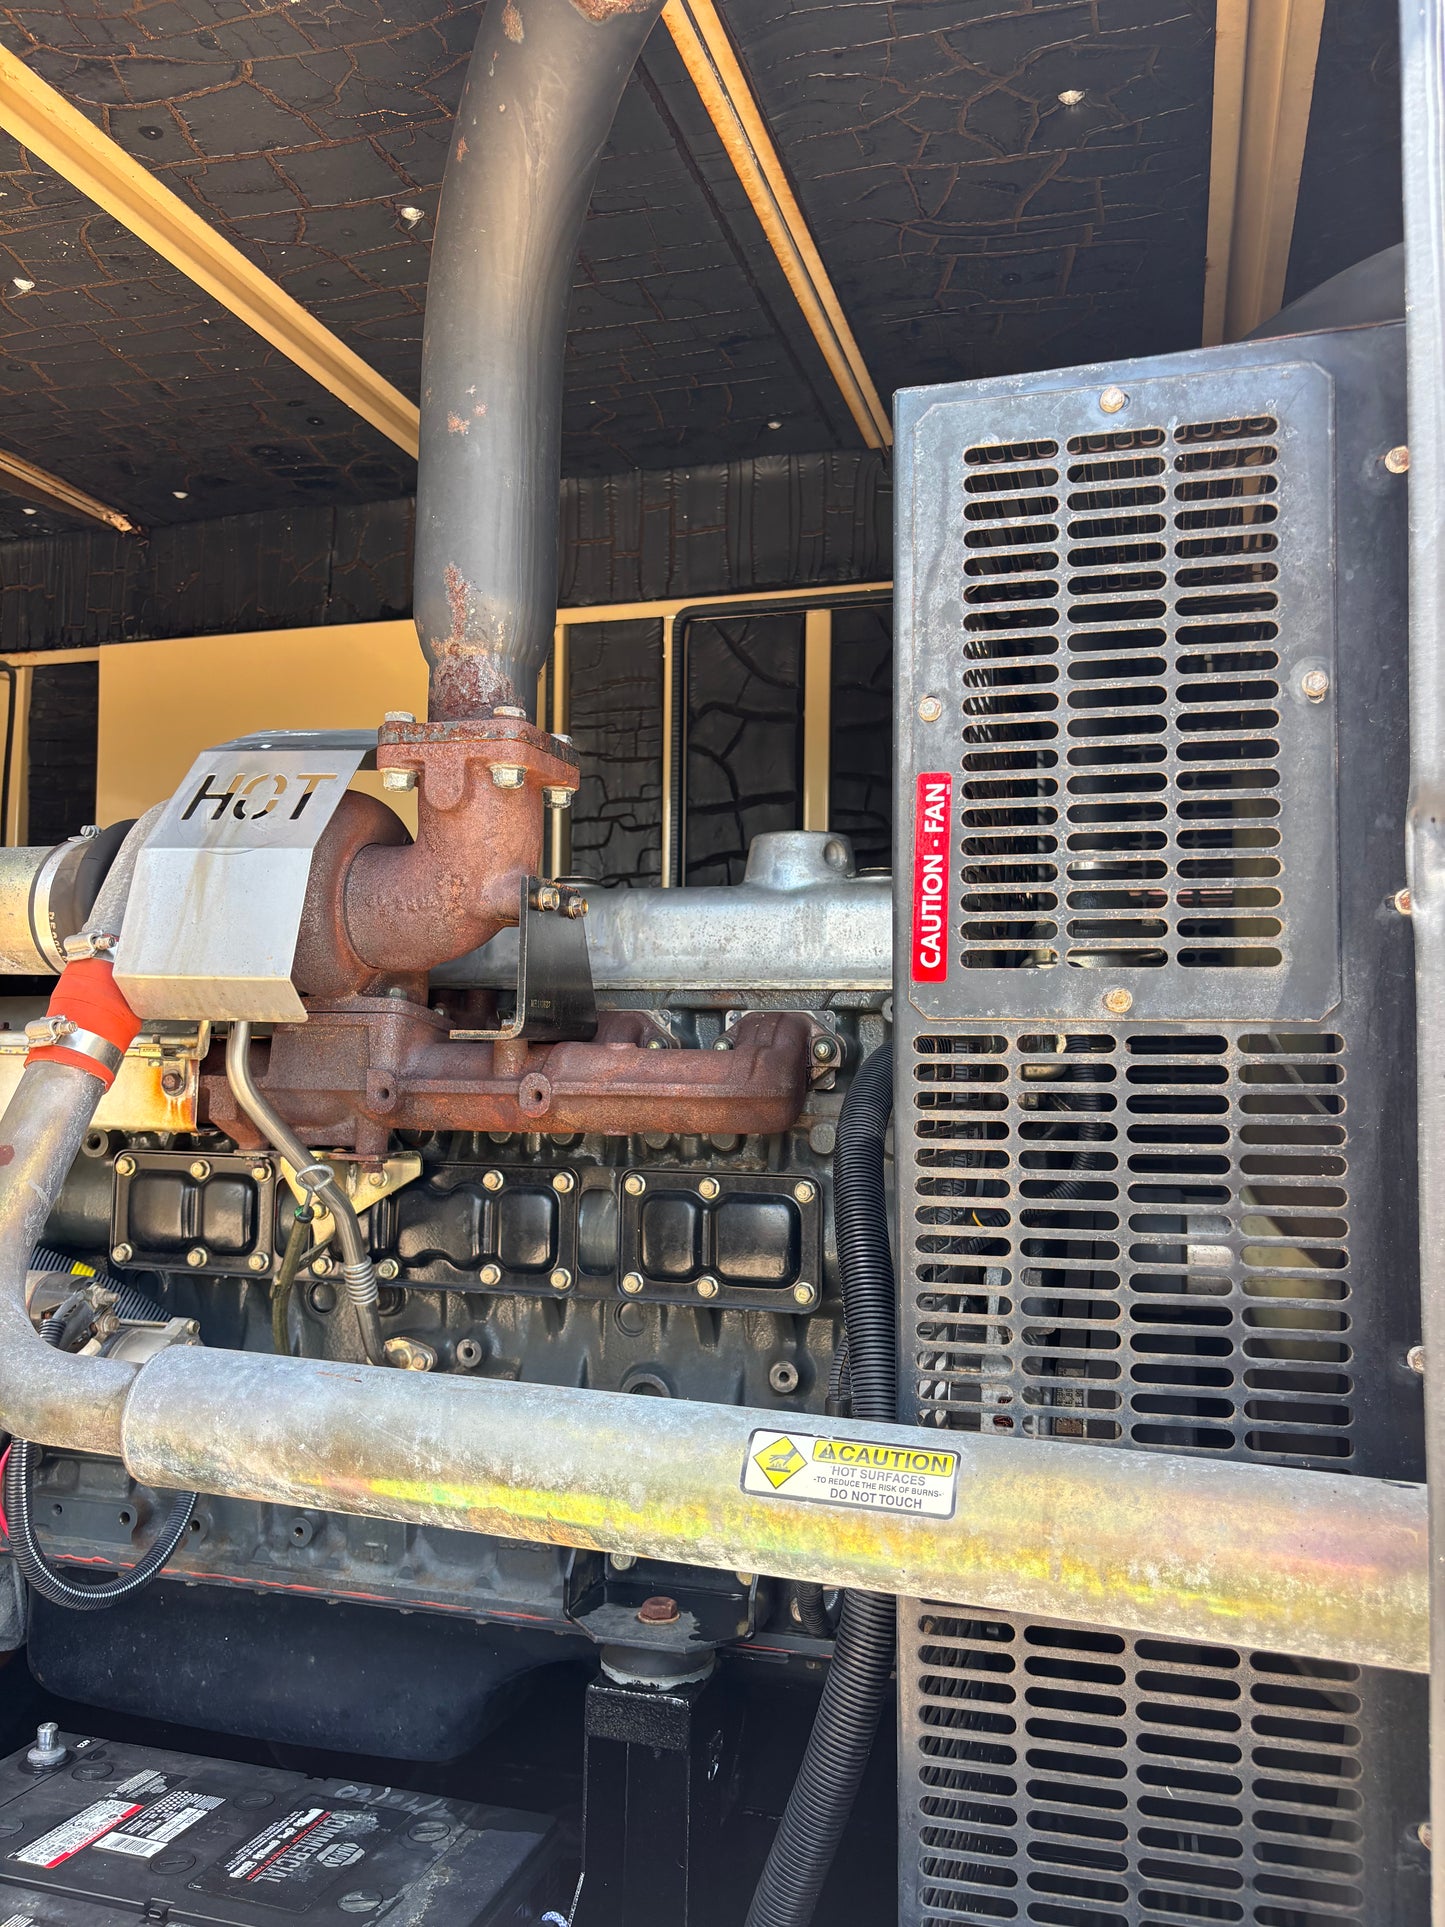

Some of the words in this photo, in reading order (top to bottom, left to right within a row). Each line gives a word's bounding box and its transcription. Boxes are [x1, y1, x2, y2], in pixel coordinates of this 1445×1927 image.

[180, 773, 338, 820] HOT
[924, 783, 946, 833] FAN
[920, 854, 944, 969] CAUTION
[839, 1445, 948, 1473] CAUTION
[828, 1477, 860, 1488] REDUCE
[862, 1481, 877, 1490] THE
[878, 1483, 897, 1493] RISK
[898, 1485, 910, 1494] OF
[832, 1466, 857, 1478] HOT
[859, 1469, 926, 1486] SURFACES
[830, 1488, 848, 1501] DO
[851, 1490, 876, 1504] NOT
[878, 1494, 922, 1509] TOUCH
[252, 1813, 354, 1883] COMMERCIAL
[326, 1844, 359, 1864] NAPA
